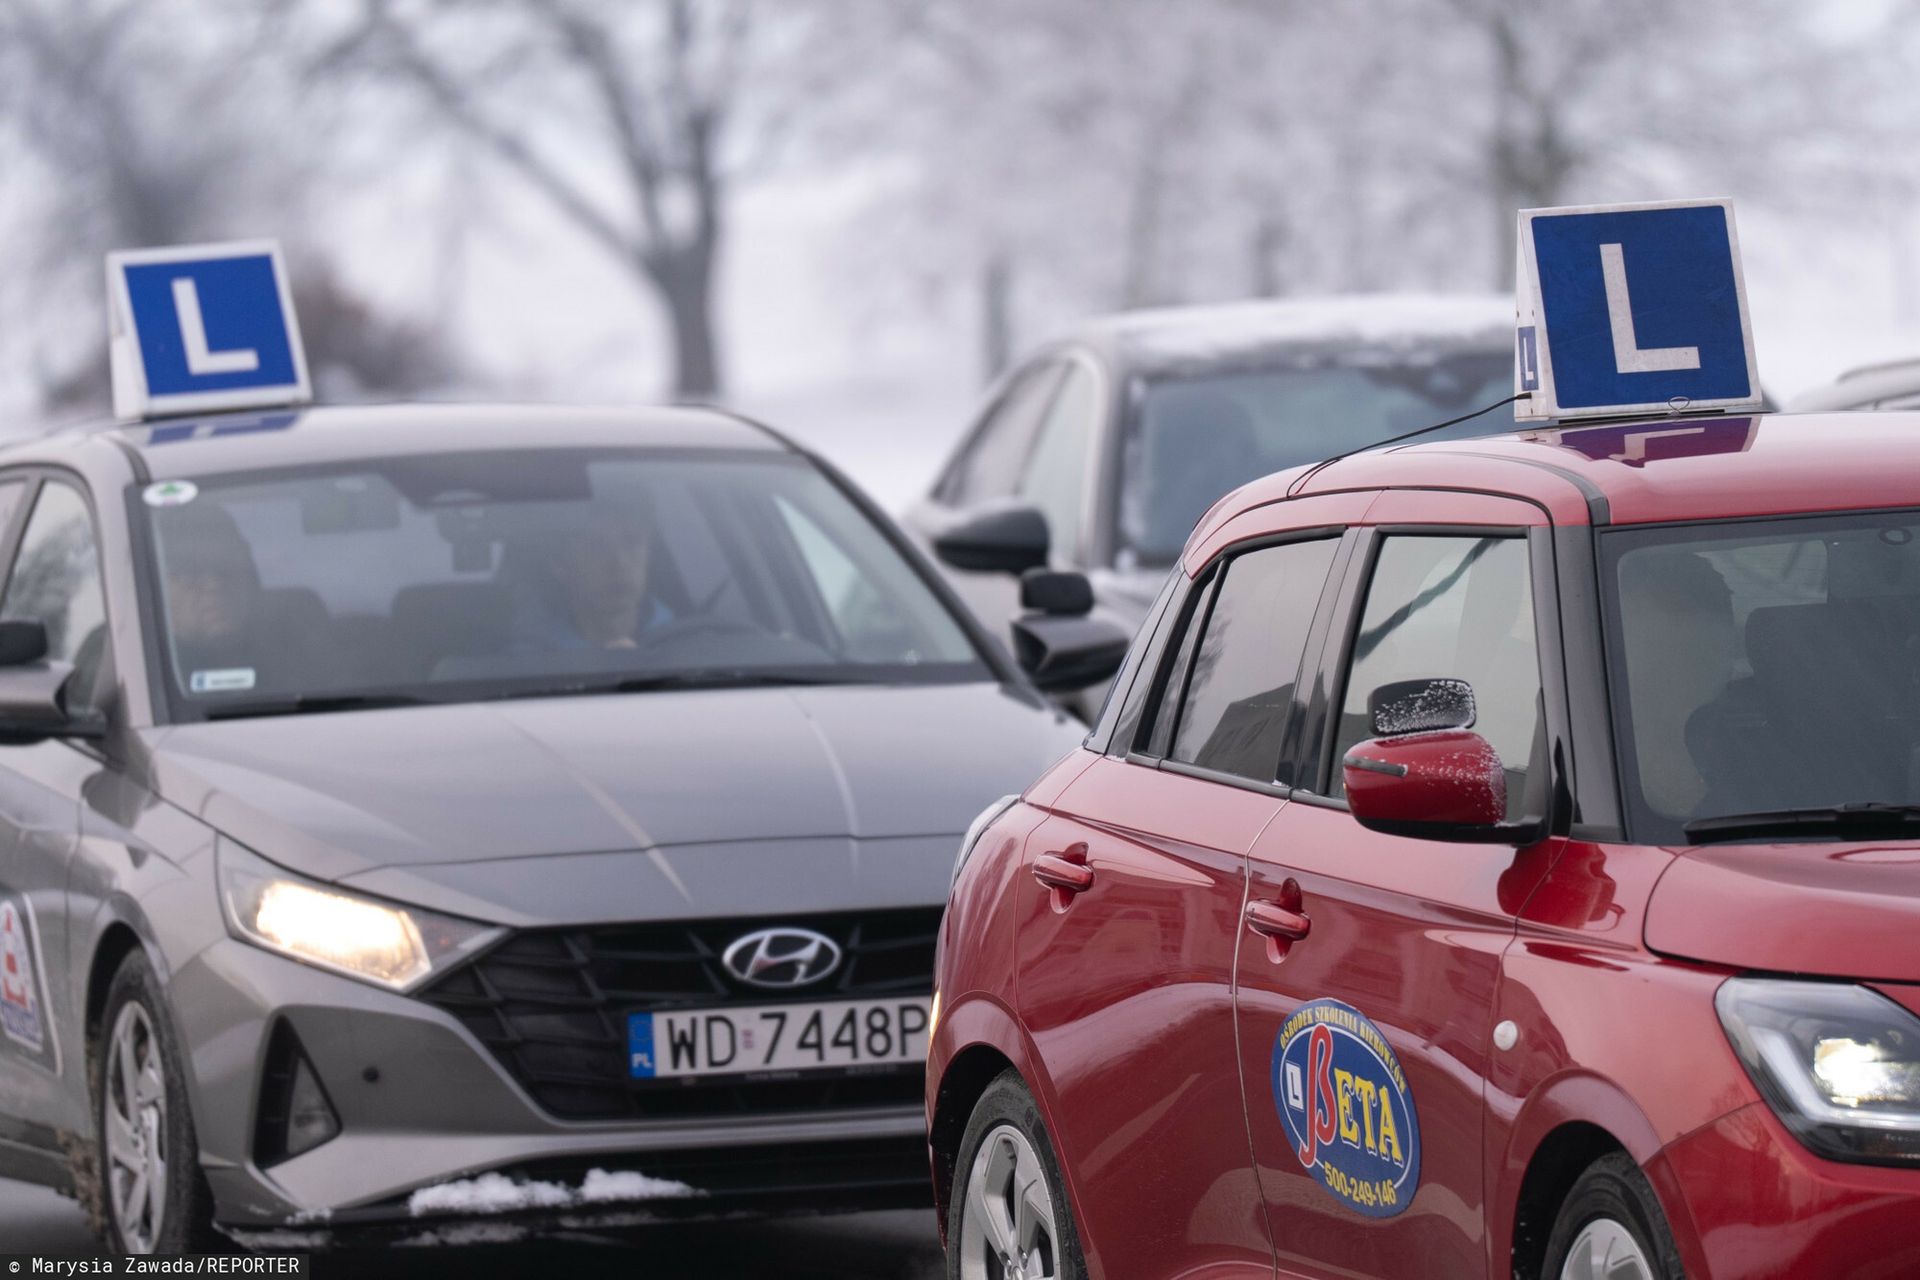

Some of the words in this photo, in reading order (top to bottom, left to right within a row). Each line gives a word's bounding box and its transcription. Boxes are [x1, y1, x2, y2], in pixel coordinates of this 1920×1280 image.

[171, 277, 260, 376] L
[1599, 243, 1702, 374] L
[1523, 336, 1535, 382] L
[632, 1053, 653, 1069] PL
[667, 1014, 737, 1070] WD
[759, 1004, 928, 1064] 7448P
[1324, 1161, 1397, 1207] 500-249-146
